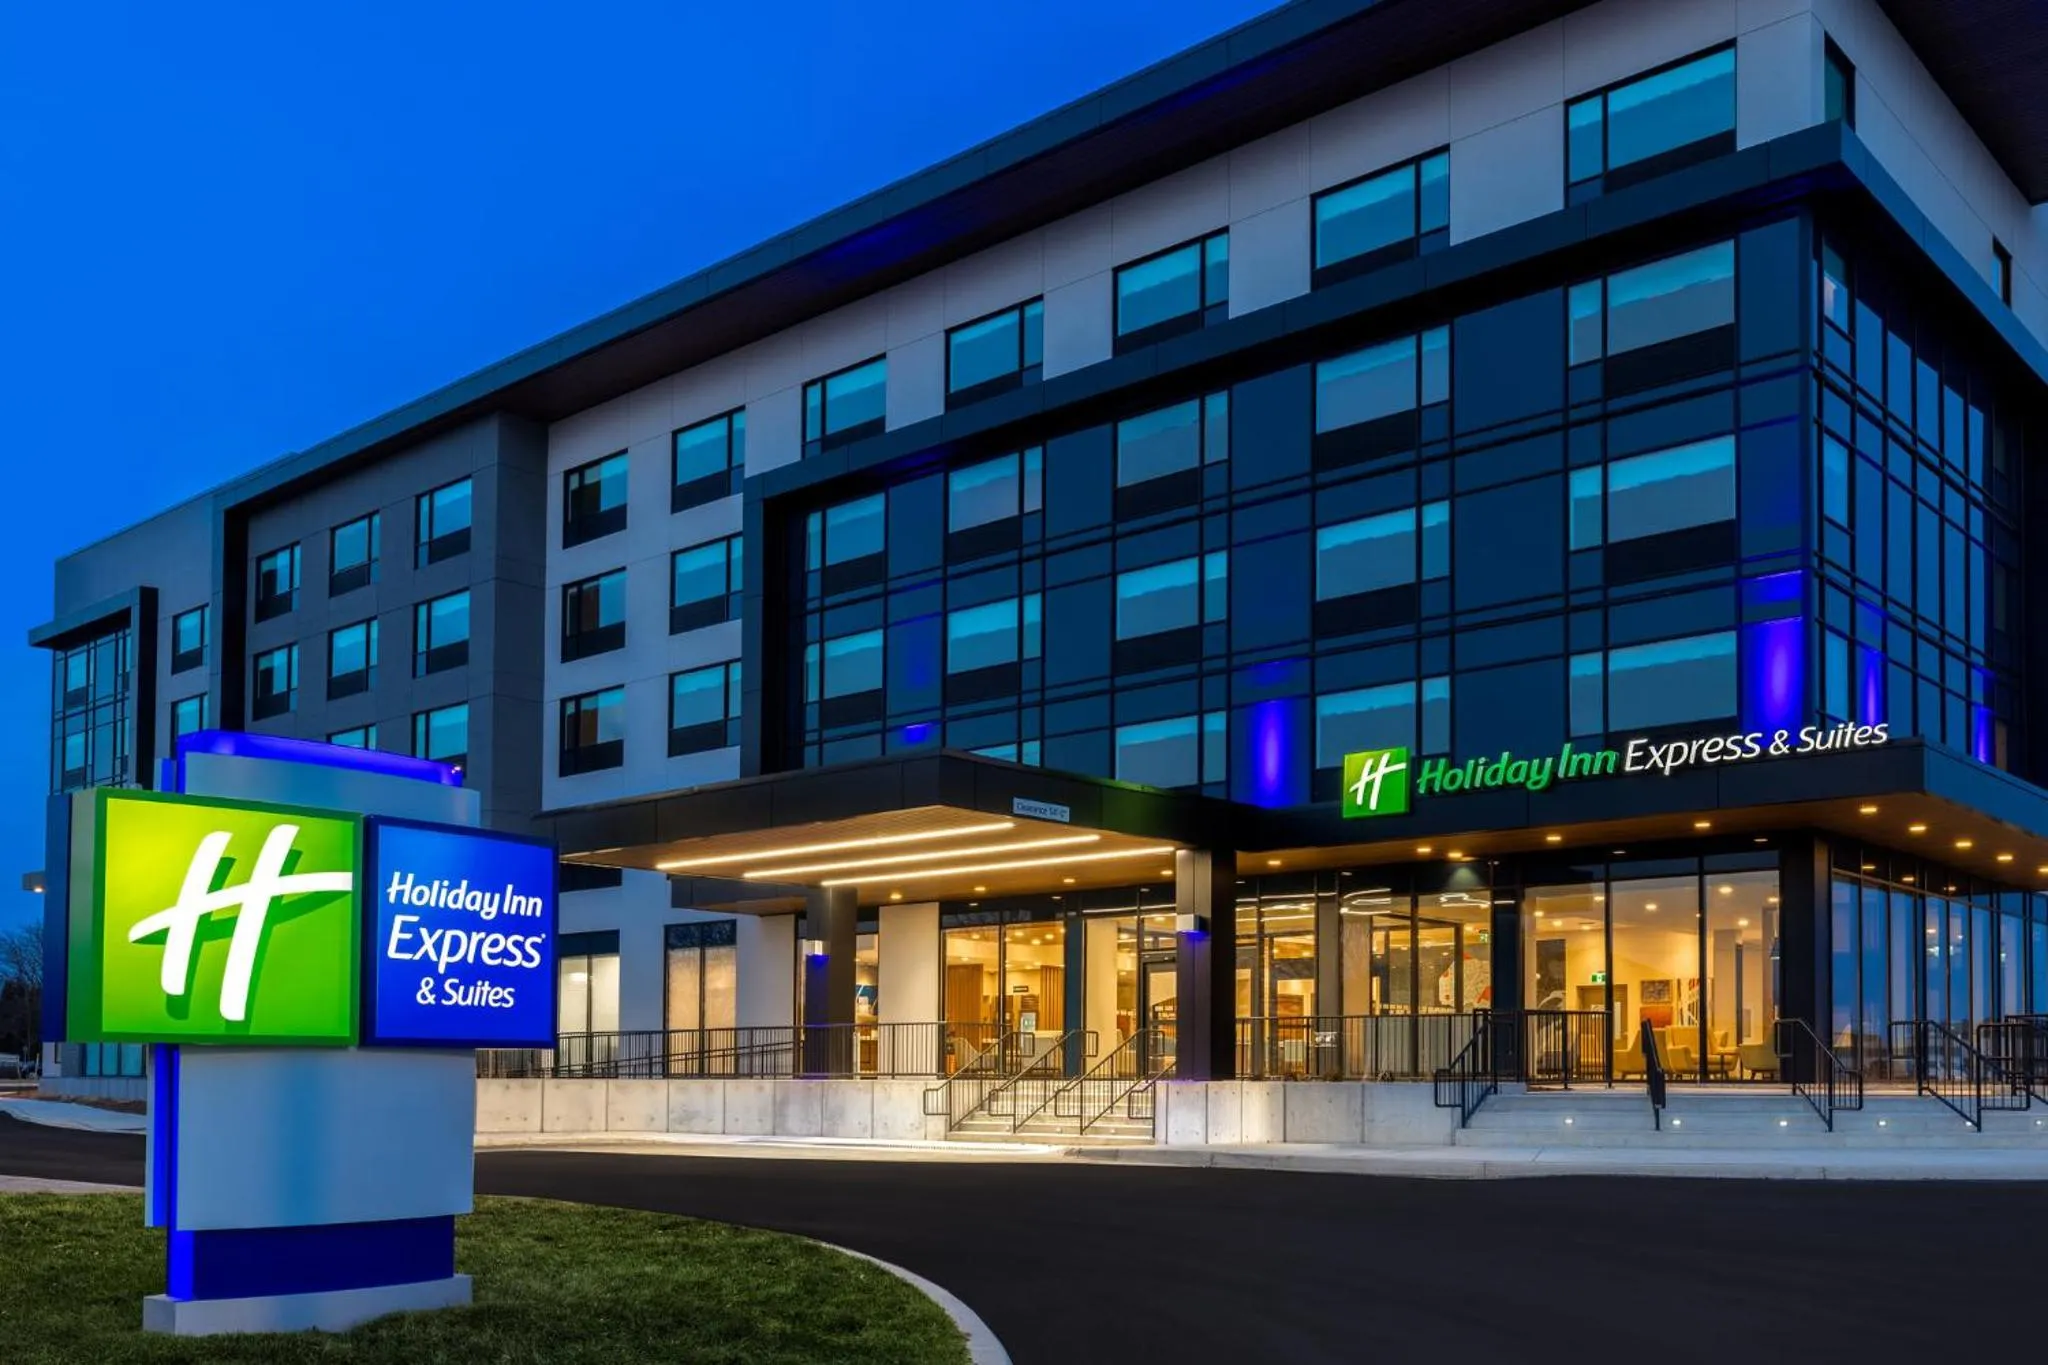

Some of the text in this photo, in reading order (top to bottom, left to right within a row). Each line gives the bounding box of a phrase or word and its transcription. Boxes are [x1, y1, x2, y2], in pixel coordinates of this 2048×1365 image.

[1416, 721, 1889, 794] Holiday Inn Express & Suites
[387, 871, 543, 920] Holiday Inn
[387, 914, 543, 975] Express
[416, 977, 515, 1008] & Suites
